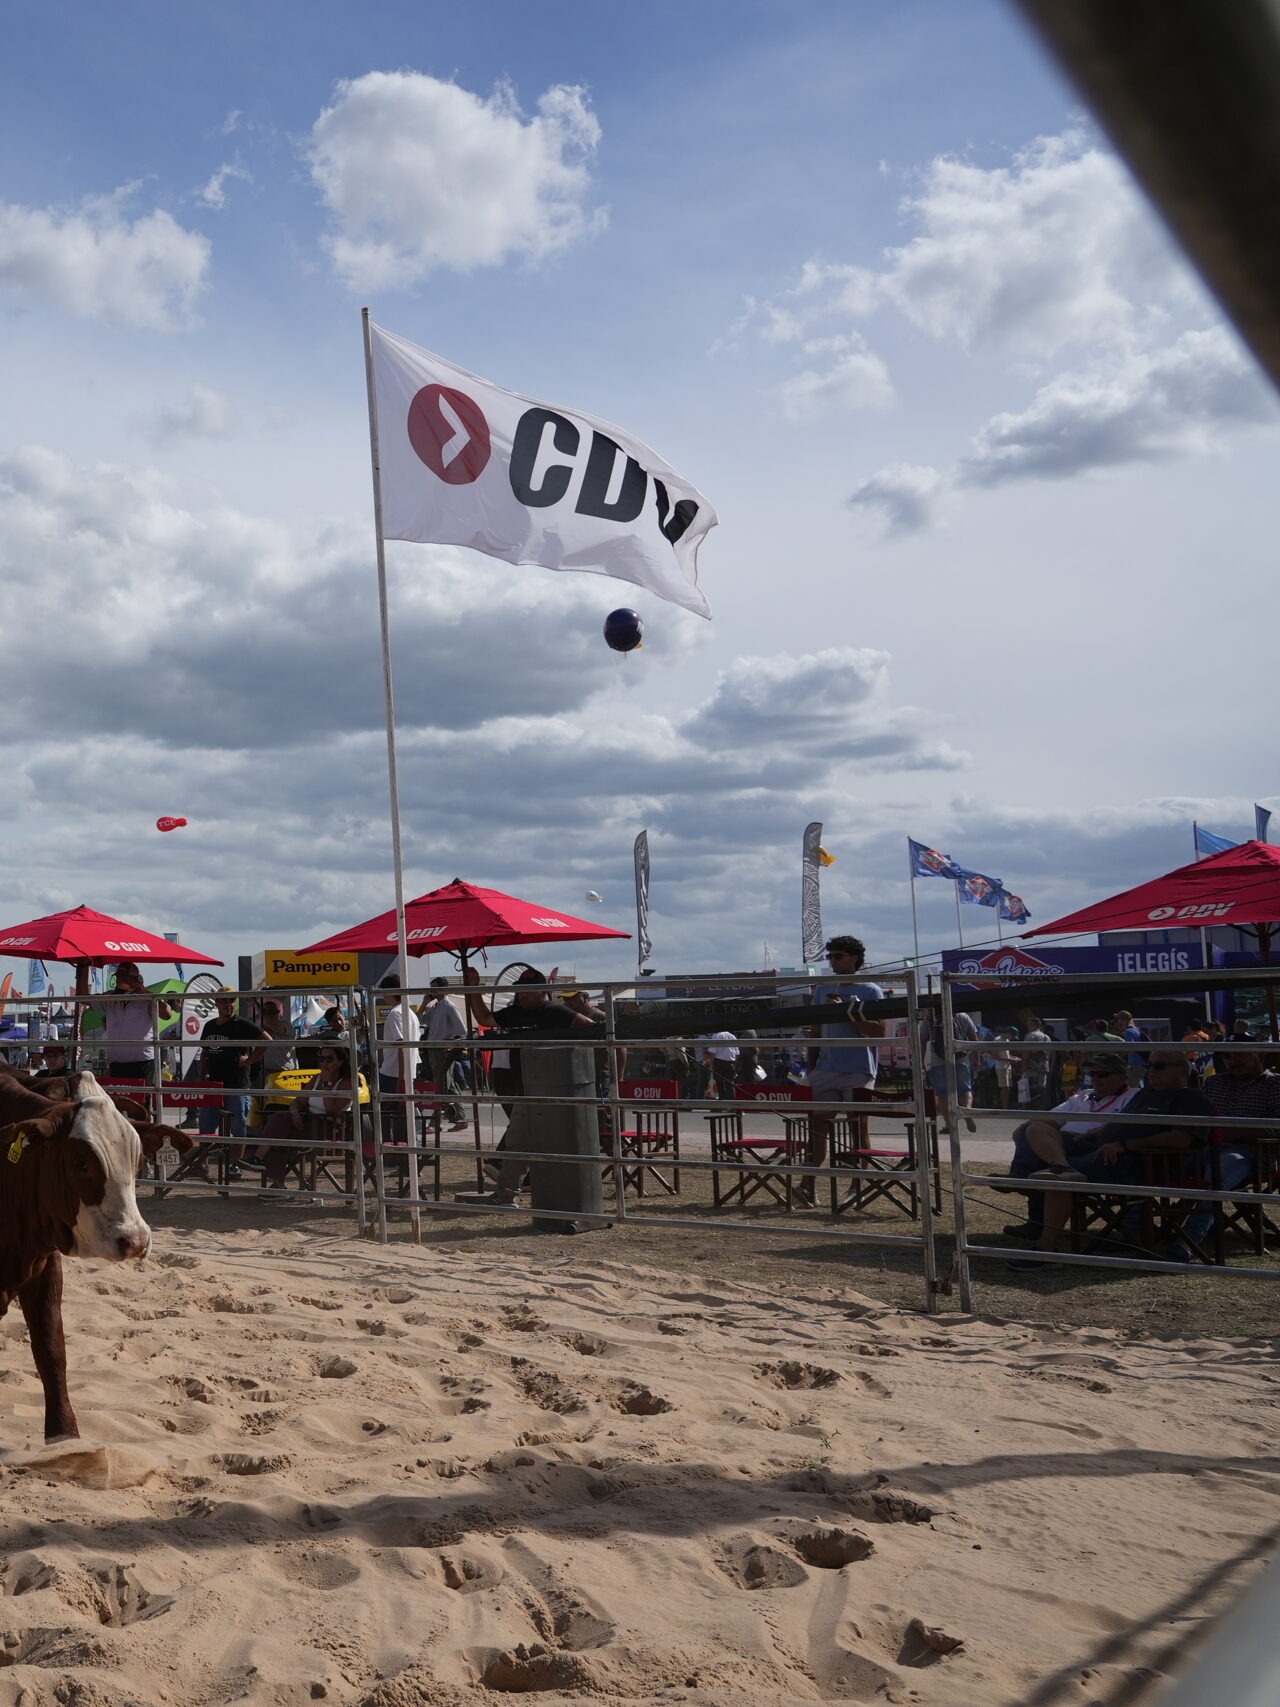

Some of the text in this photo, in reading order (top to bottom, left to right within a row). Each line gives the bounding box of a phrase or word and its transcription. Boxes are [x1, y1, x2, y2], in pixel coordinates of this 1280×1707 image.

[509, 407, 700, 548] CDV
[1176, 902, 1237, 919] CDV
[407, 925, 448, 940] CDV
[12, 937, 38, 946] CDV
[120, 942, 151, 953] CDV
[272, 960, 351, 975] Pampero
[644, 1087, 662, 1099] CDV
